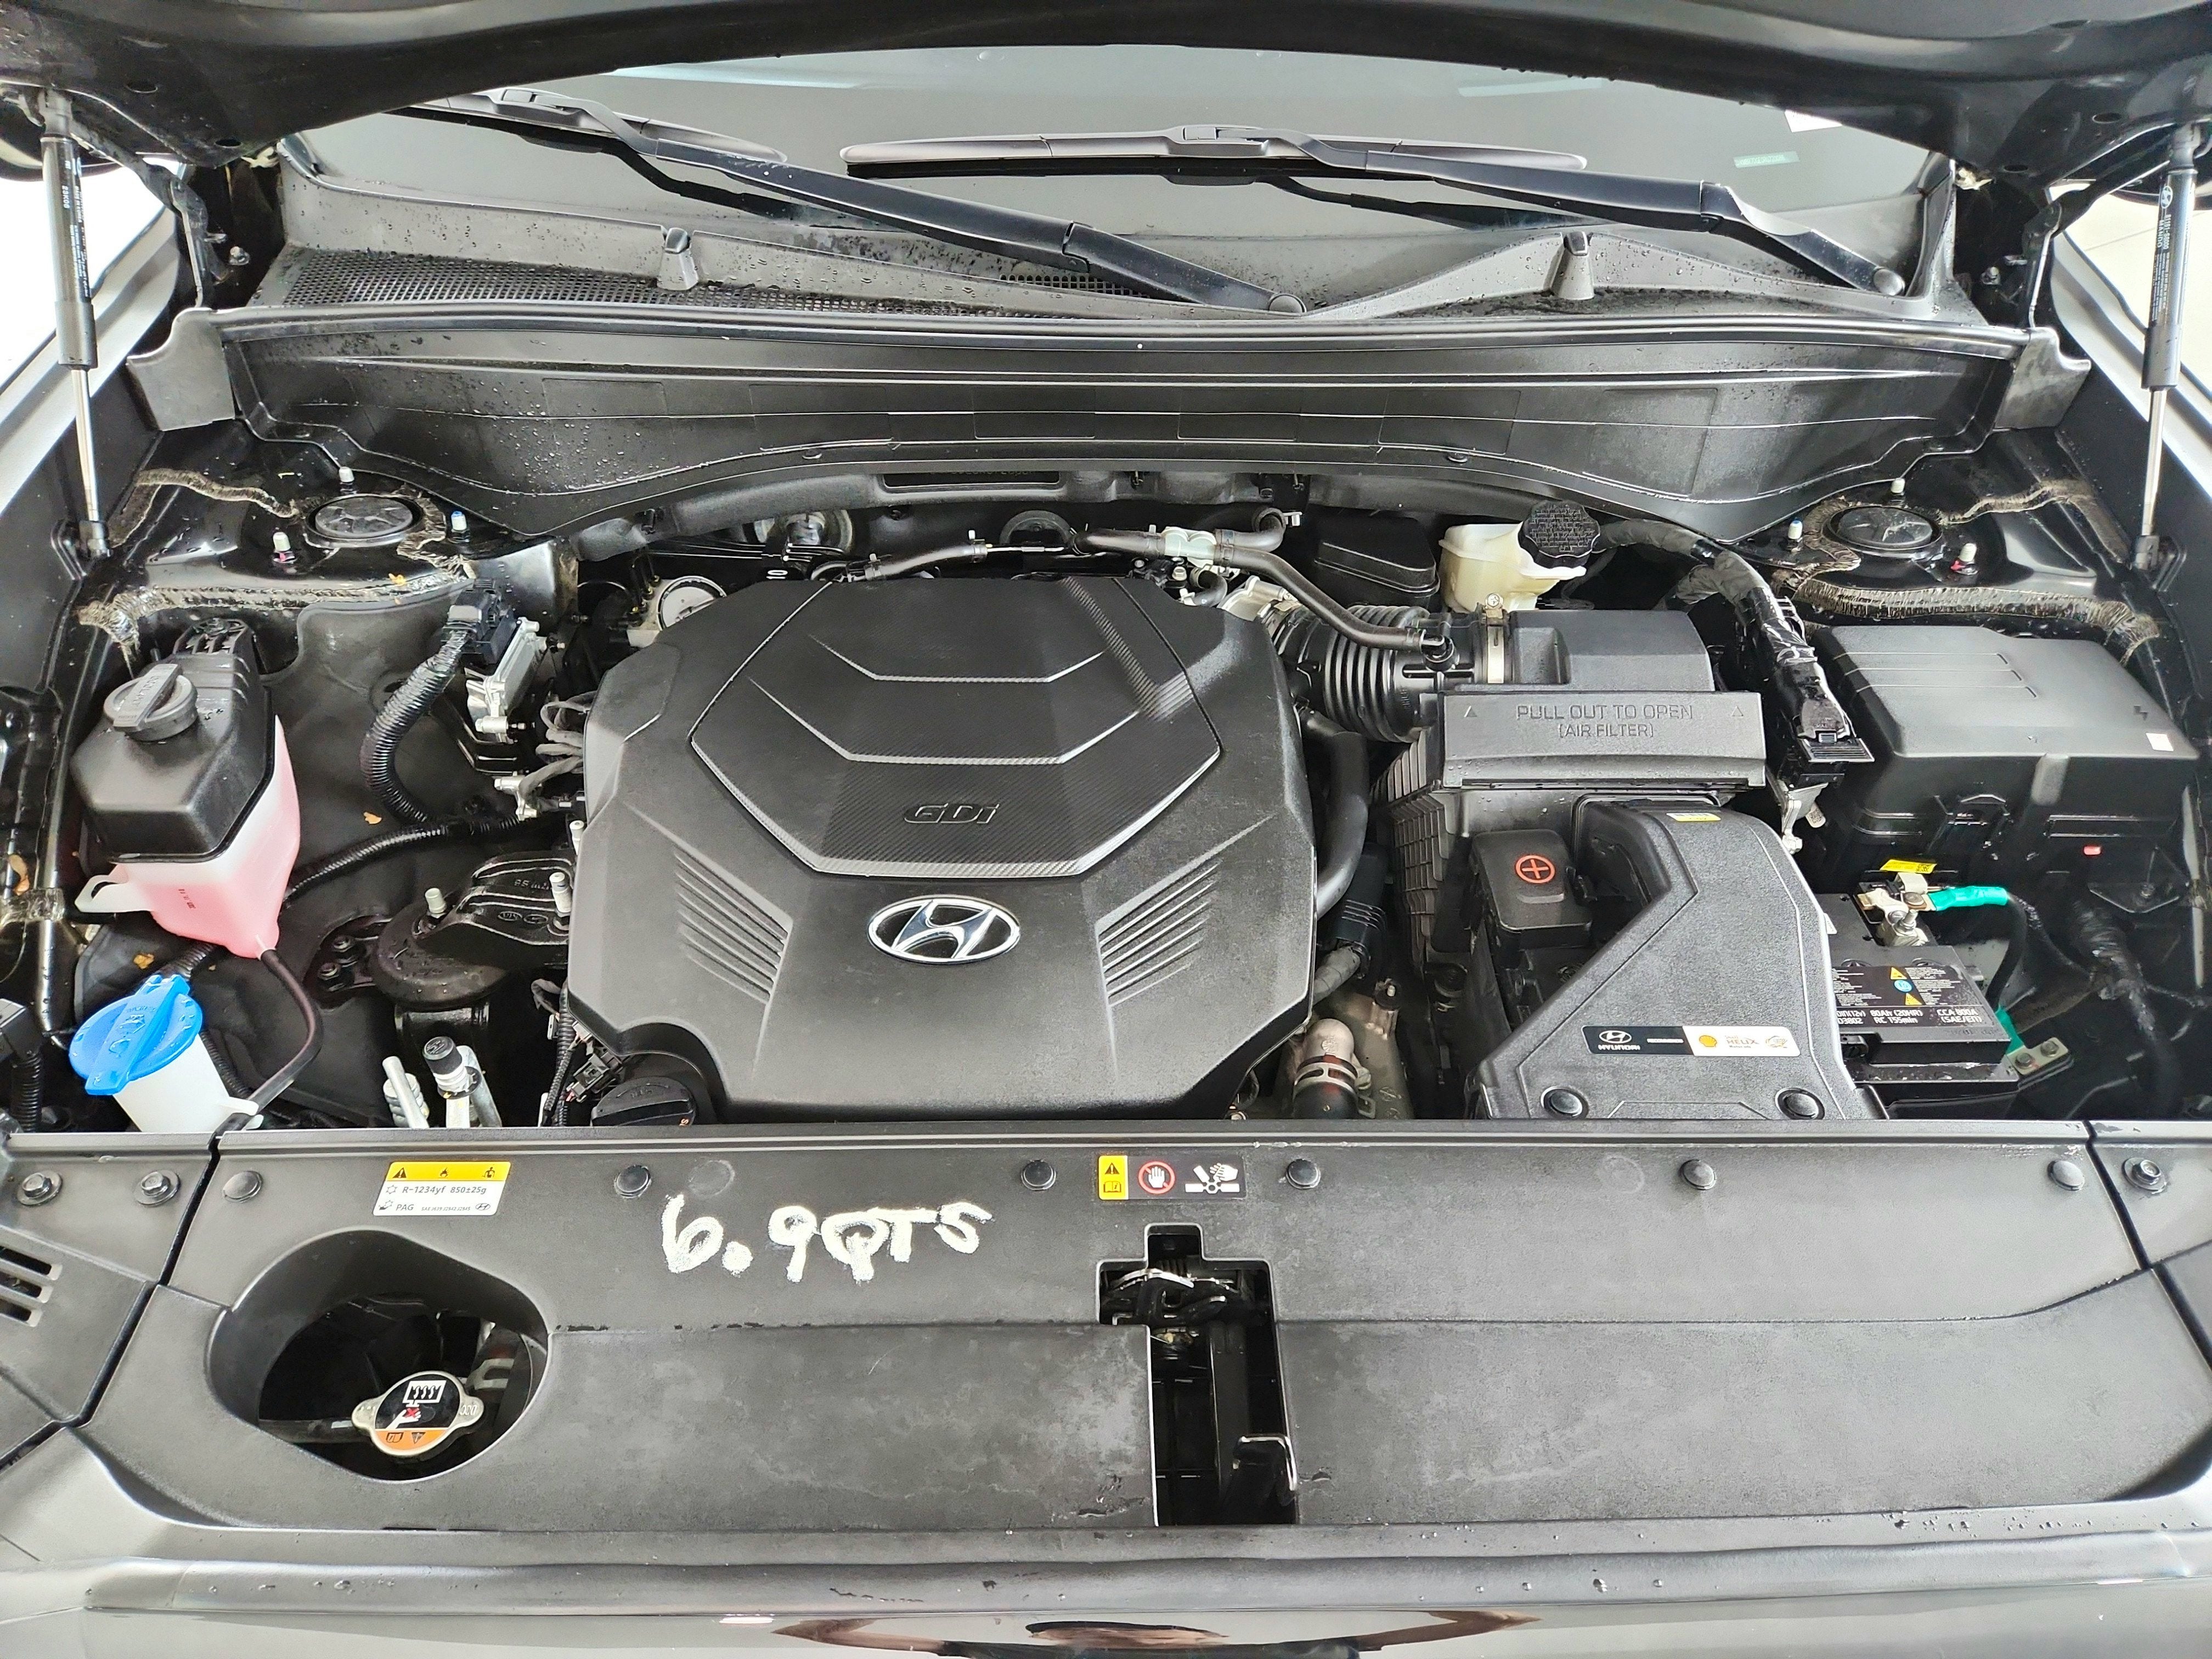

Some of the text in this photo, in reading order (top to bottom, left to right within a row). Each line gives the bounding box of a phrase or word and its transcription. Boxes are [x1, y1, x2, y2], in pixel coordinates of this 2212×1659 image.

[1516, 704, 1694, 720] PULL OUT TO OPEN
[402, 1186, 487, 1195] R-1234yf 850±25g
